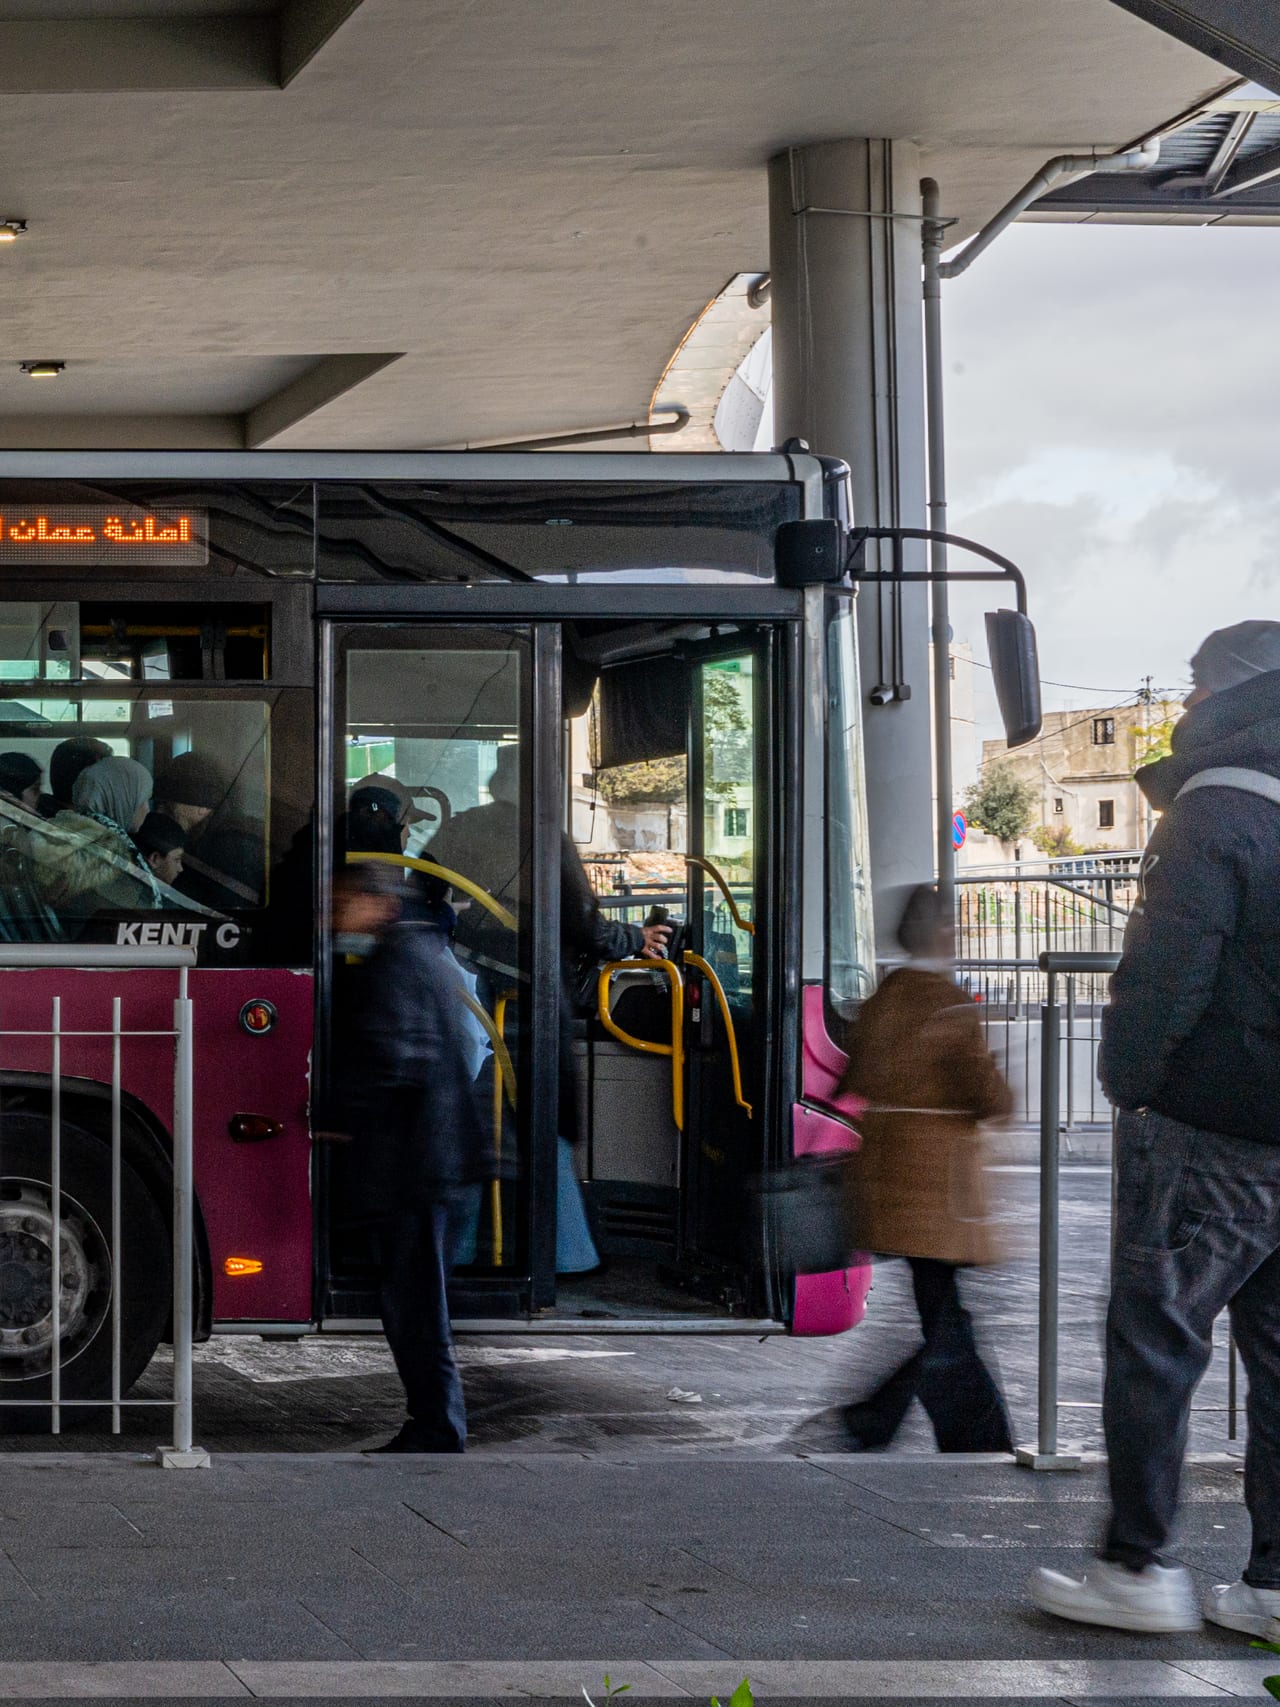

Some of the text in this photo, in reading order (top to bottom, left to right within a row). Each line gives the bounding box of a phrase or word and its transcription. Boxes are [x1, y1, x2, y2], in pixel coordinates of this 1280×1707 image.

[10, 515, 95, 541] عمان
[116, 922, 240, 949] KENT C
